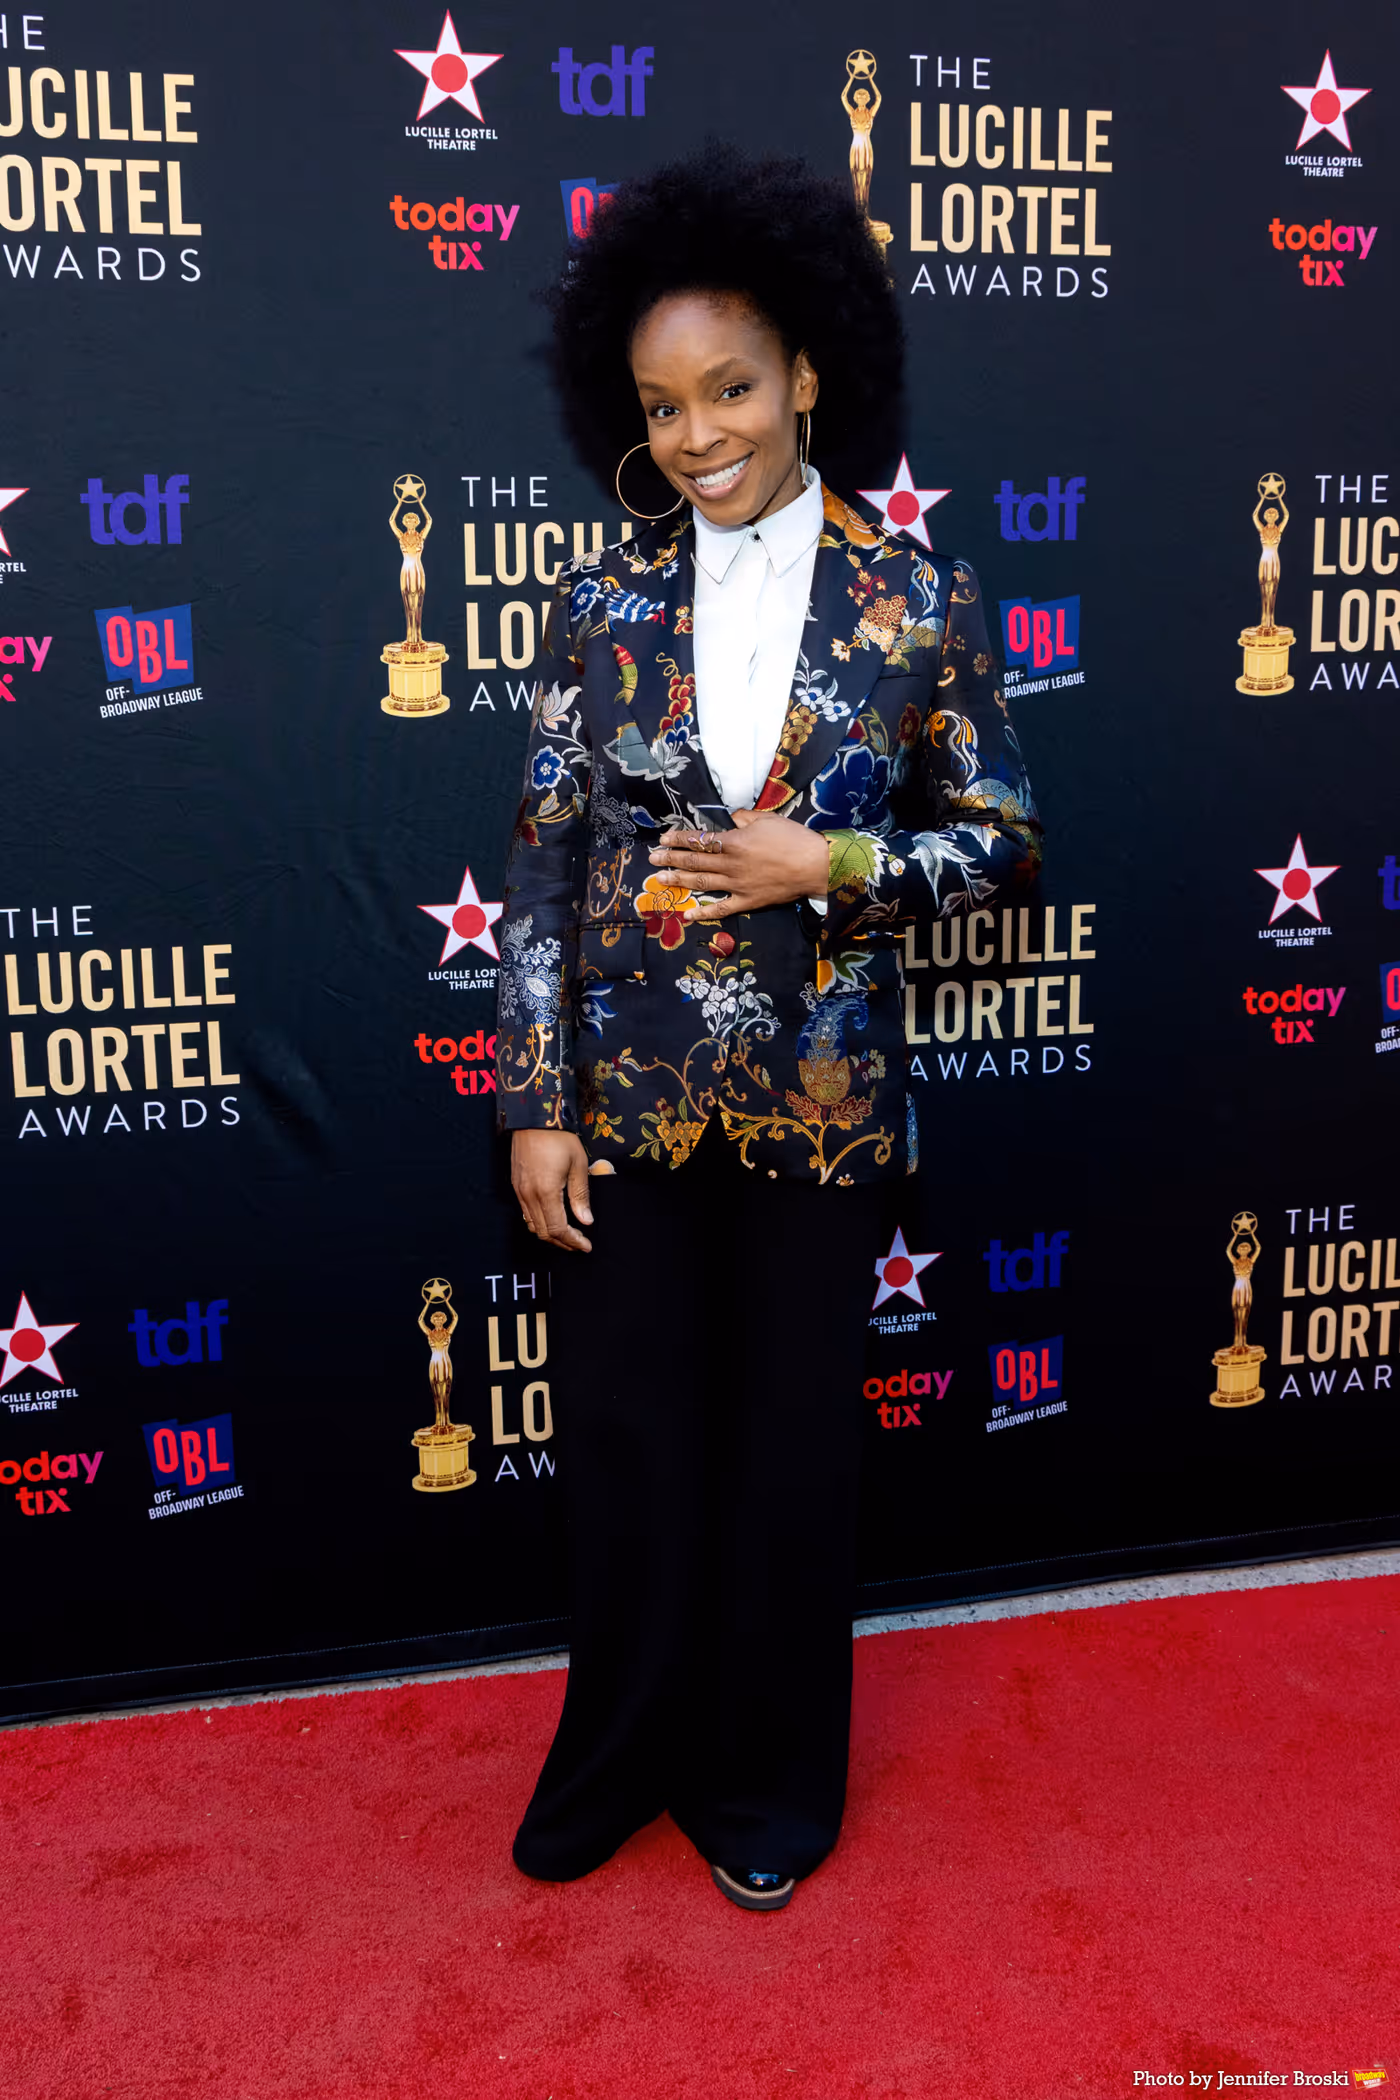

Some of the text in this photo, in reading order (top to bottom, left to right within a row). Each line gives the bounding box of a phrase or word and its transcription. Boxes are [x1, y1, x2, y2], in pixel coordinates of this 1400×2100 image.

[551, 45, 654, 117] tdf
[910, 54, 990, 90] THE
[405, 126, 498, 140] LUCILLE LORTEL
[427, 138, 476, 151] THEATRE
[910, 102, 1112, 172] LUCILLE
[1285, 155, 1363, 168] LUCILLE LORTEL
[1303, 166, 1344, 178] THEATRE
[0, 154, 202, 236] ORTEL
[389, 195, 519, 240] today
[910, 182, 1111, 256] LORTEL
[428, 235, 484, 271] tix
[1269, 218, 1378, 259] today
[3, 244, 201, 282] WARDS
[1299, 254, 1345, 287] tix
[910, 264, 1109, 298] AWARDS
[461, 476, 548, 507] THE
[1315, 475, 1389, 503] THE
[80, 474, 189, 545] tdf
[994, 476, 1086, 541] tdf
[464, 522, 632, 586] LUCI
[1313, 516, 1400, 575] LUC
[466, 601, 551, 670] LO
[1008, 605, 1074, 668] OBL
[1310, 588, 1400, 653] LOR
[106, 615, 188, 684] OBL
[1003, 669, 1024, 684] OFF-
[1003, 671, 1086, 699] ROADWAY LEAGUE
[1309, 661, 1400, 691] AWA
[100, 687, 203, 718] BROADWAY LEAGUE
[106, 686, 130, 701] OFF-
[0, 905, 93, 938] THE
[905, 904, 1096, 969] LUCILLE
[1258, 927, 1332, 938] LUCILLE LORTEL
[1275, 937, 1315, 947] THEATRE
[4, 943, 235, 1016] LUCILLE
[428, 969, 470, 981] LUCILLE
[449, 979, 495, 991] THEATRE
[905, 974, 1095, 1045] LORTEL
[1243, 984, 1346, 1017] today
[1271, 1015, 1315, 1045] tix
[1375, 1037, 1400, 1053] BROA
[10, 1021, 240, 1098] LORTEL
[910, 1044, 1092, 1081] AWARDS
[18, 1096, 241, 1139] AWARDS
[1285, 1204, 1355, 1234] THE
[983, 1230, 1070, 1293] tdf
[1283, 1238, 1400, 1298] LUCIL
[485, 1272, 551, 1302] TH
[128, 1299, 229, 1367] tdf
[878, 1323, 919, 1335] THEATRE
[901, 1312, 938, 1323] LORTEL
[488, 1312, 548, 1372] LU
[996, 1348, 1058, 1402] OBL
[1279, 1364, 1392, 1400] AWAR
[0, 1388, 79, 1403] CILLE LORTEL
[9, 1400, 58, 1414] THEATRE
[991, 1404, 1011, 1419] OFF-
[491, 1381, 554, 1446] LO
[877, 1402, 922, 1429] tix
[986, 1401, 1068, 1433] BROADWAY LEAGUE
[153, 1428, 229, 1486] OBL
[15, 1486, 72, 1516] tix
[148, 1486, 244, 1521] BROADWAY LEAGUE
[153, 1492, 177, 1505] OFF-
